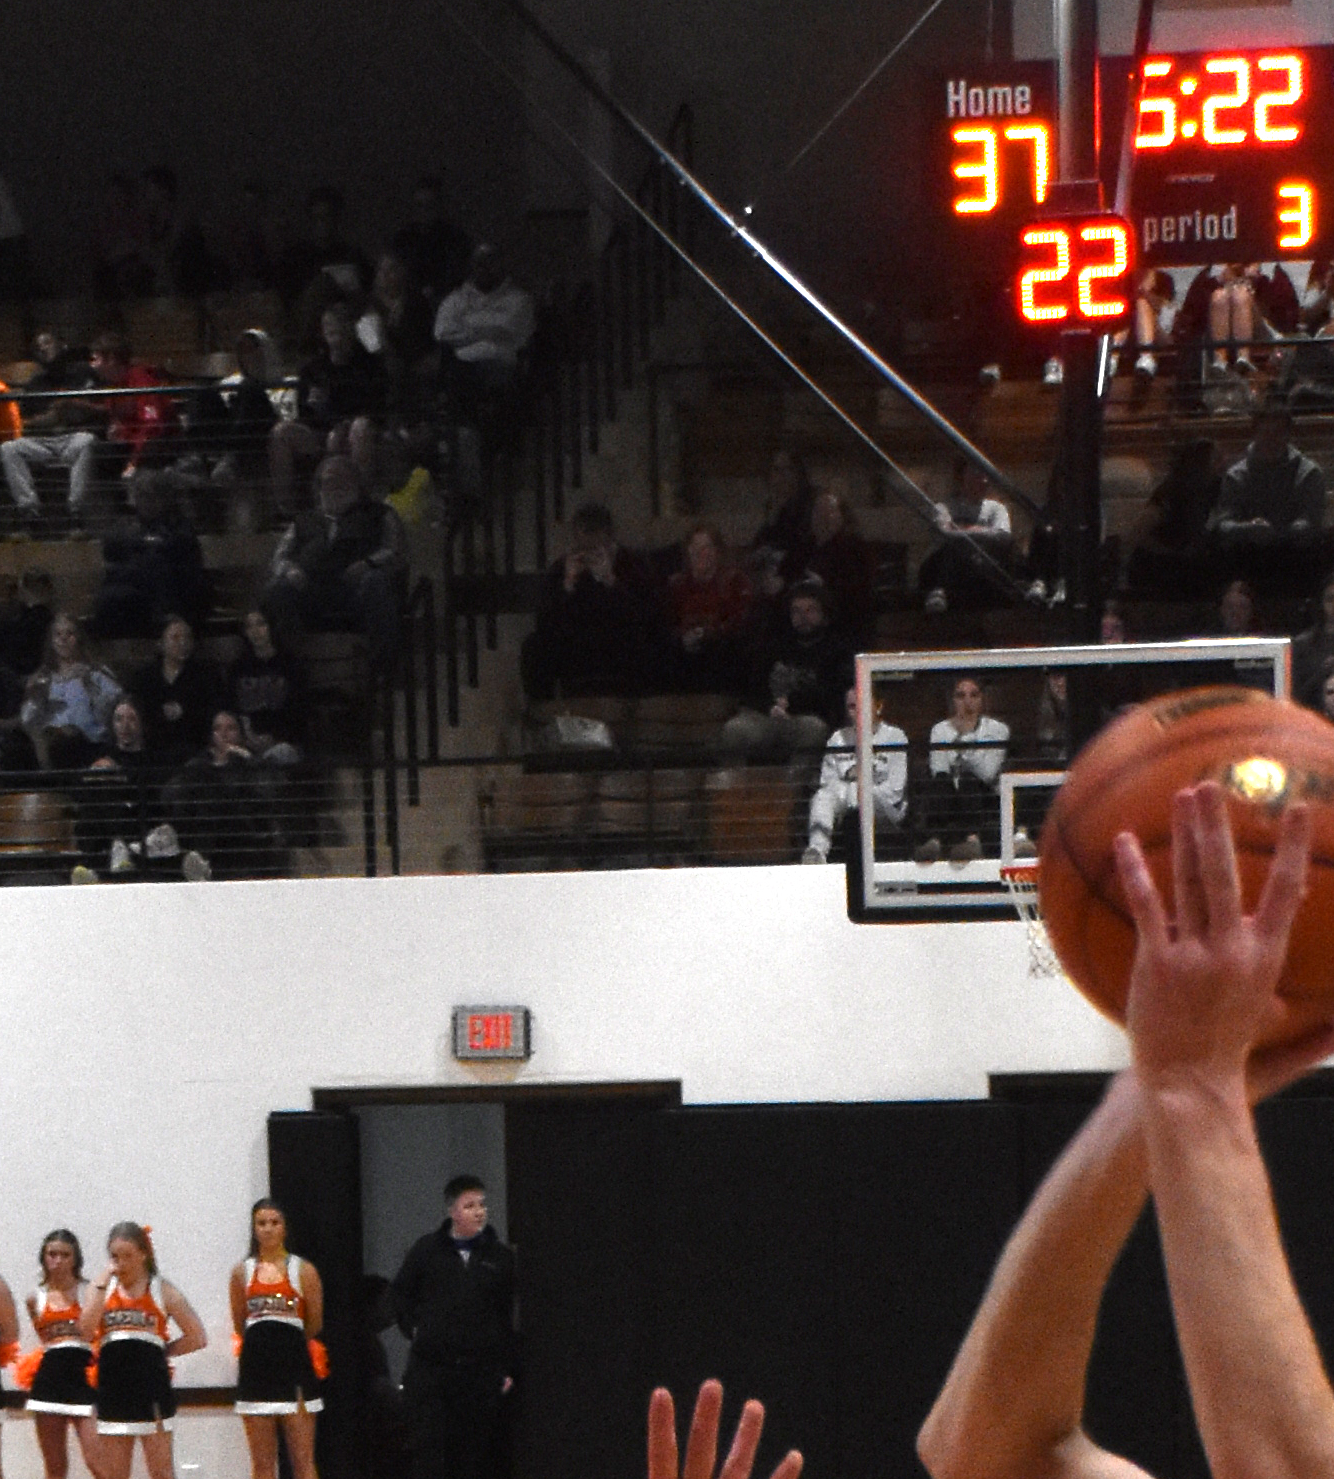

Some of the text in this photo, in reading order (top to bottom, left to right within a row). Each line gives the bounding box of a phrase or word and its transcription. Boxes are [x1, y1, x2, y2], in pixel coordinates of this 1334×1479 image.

[947, 80, 1032, 119] Home
[952, 124, 1050, 214] 37
[1142, 184, 1313, 253] period 3
[1020, 225, 1129, 322] 22
